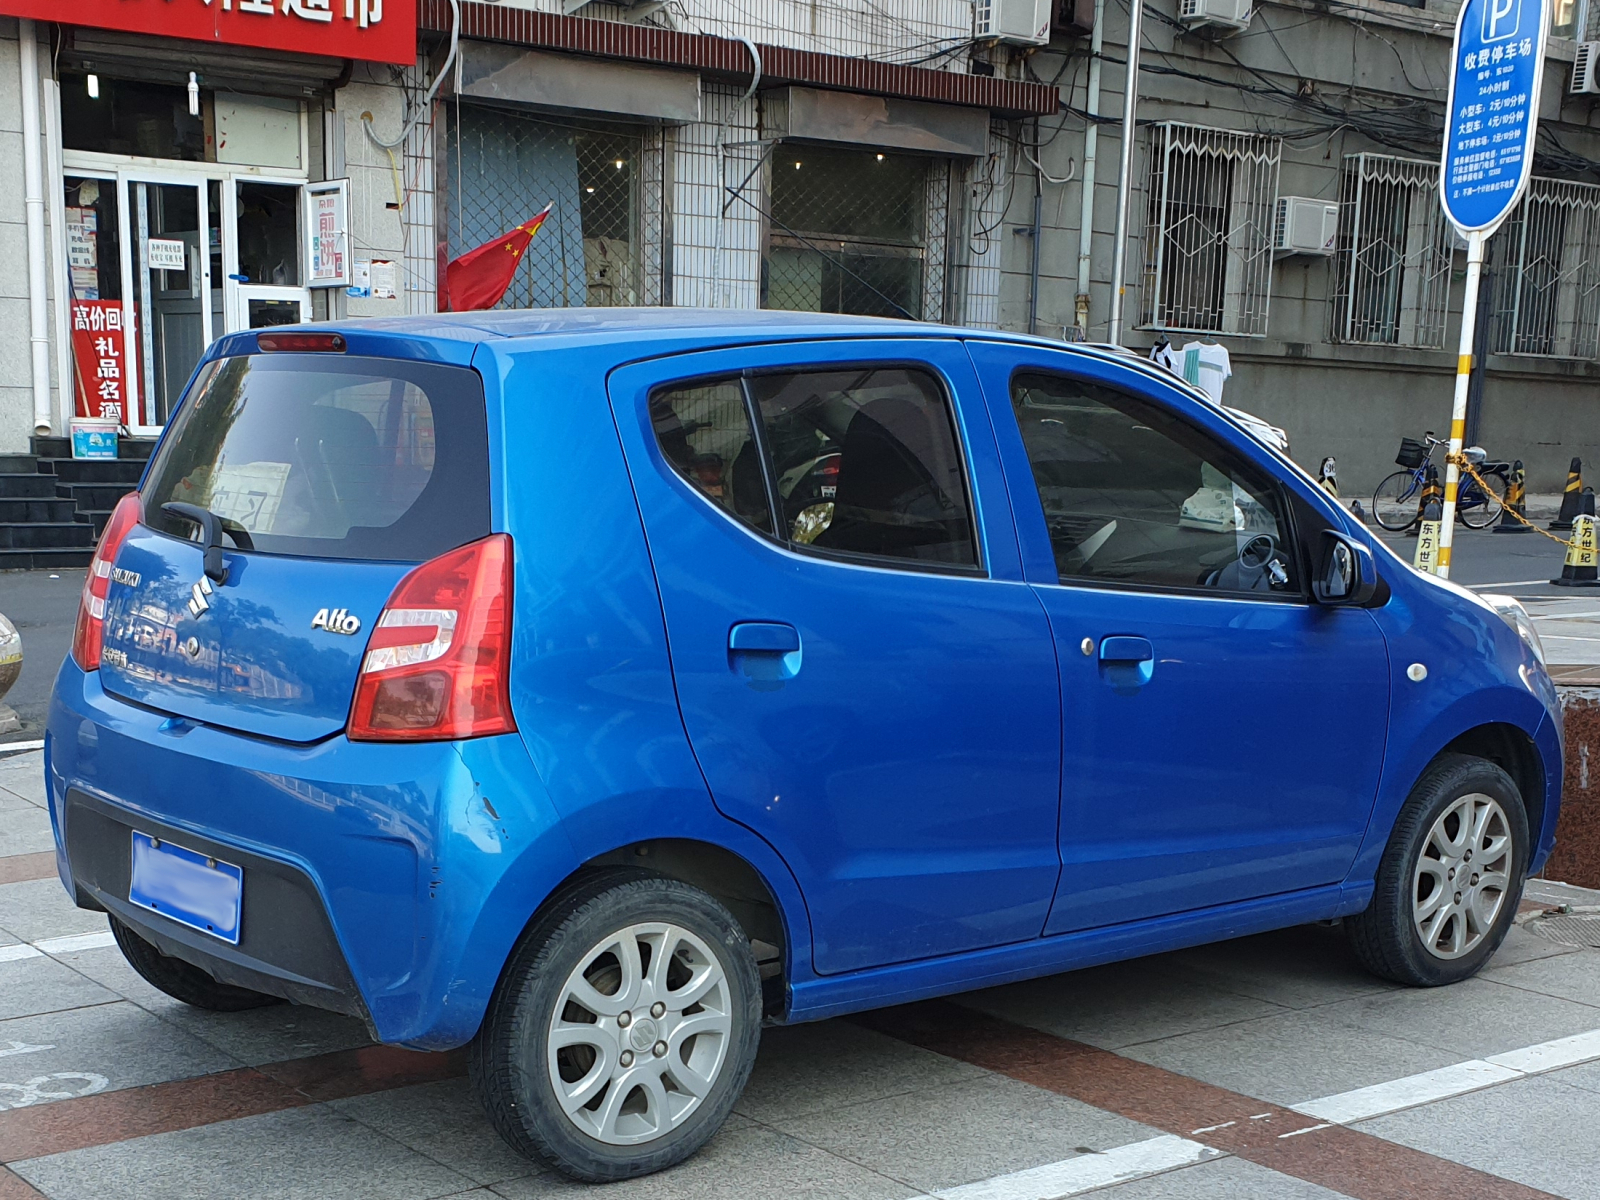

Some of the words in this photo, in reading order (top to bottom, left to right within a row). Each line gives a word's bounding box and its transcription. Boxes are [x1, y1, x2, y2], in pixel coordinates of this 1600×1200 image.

[1489, 0, 1513, 38] P
[1464, 37, 1532, 71] 收费停车场
[95, 336, 122, 418] 礼品名酒
[311, 608, 361, 636] Alto
